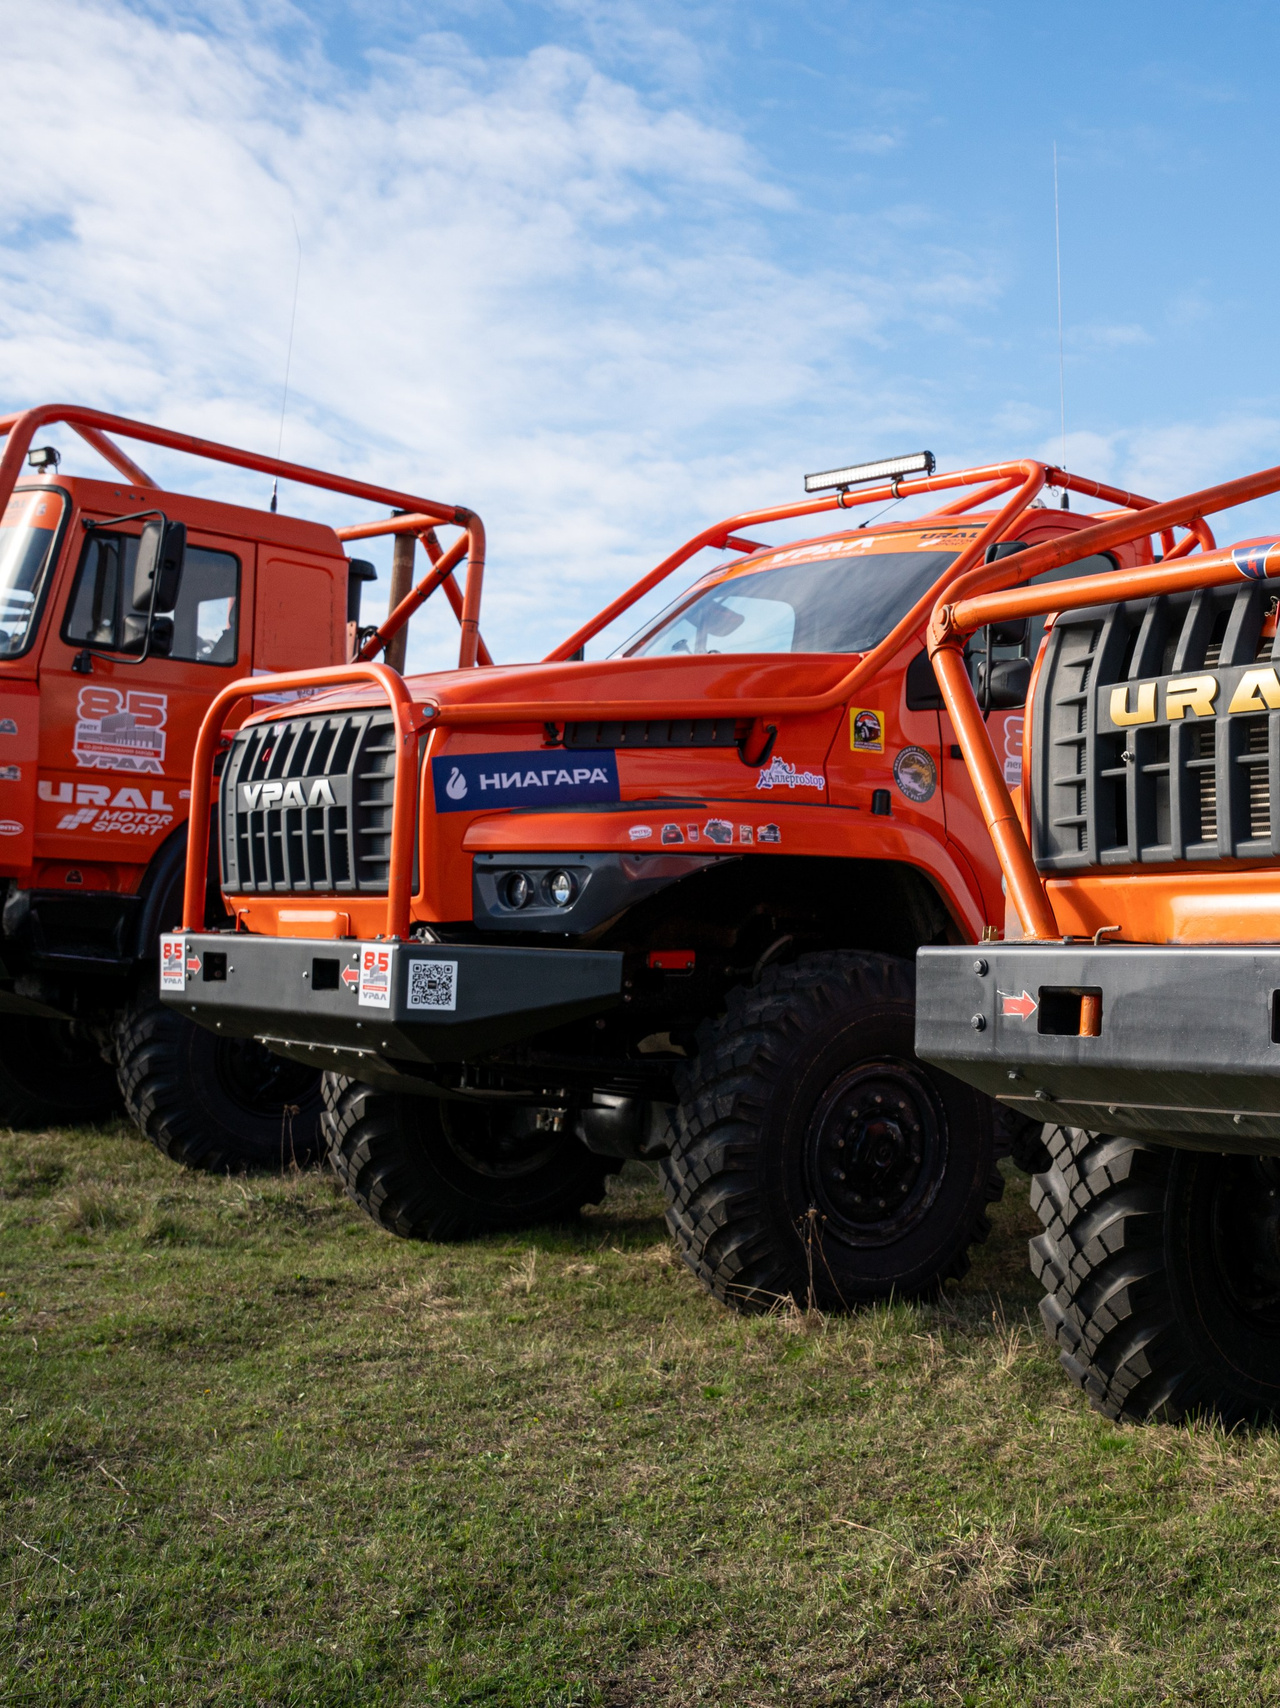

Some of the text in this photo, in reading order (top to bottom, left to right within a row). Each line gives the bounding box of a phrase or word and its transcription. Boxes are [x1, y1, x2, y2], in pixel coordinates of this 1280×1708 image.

[771, 537, 875, 563] УРАЛ
[77, 685, 168, 730] 85
[76, 752, 161, 773] УРАЛ
[479, 768, 609, 790] НИАГАРА
[37, 780, 174, 812] URAL
[243, 779, 337, 810] УРАЛ
[100, 809, 174, 826] MOTOR
[92, 821, 164, 836] SPORT
[164, 943, 183, 960] 85
[364, 951, 389, 972] 85
[362, 991, 387, 1001] УРАЛ
